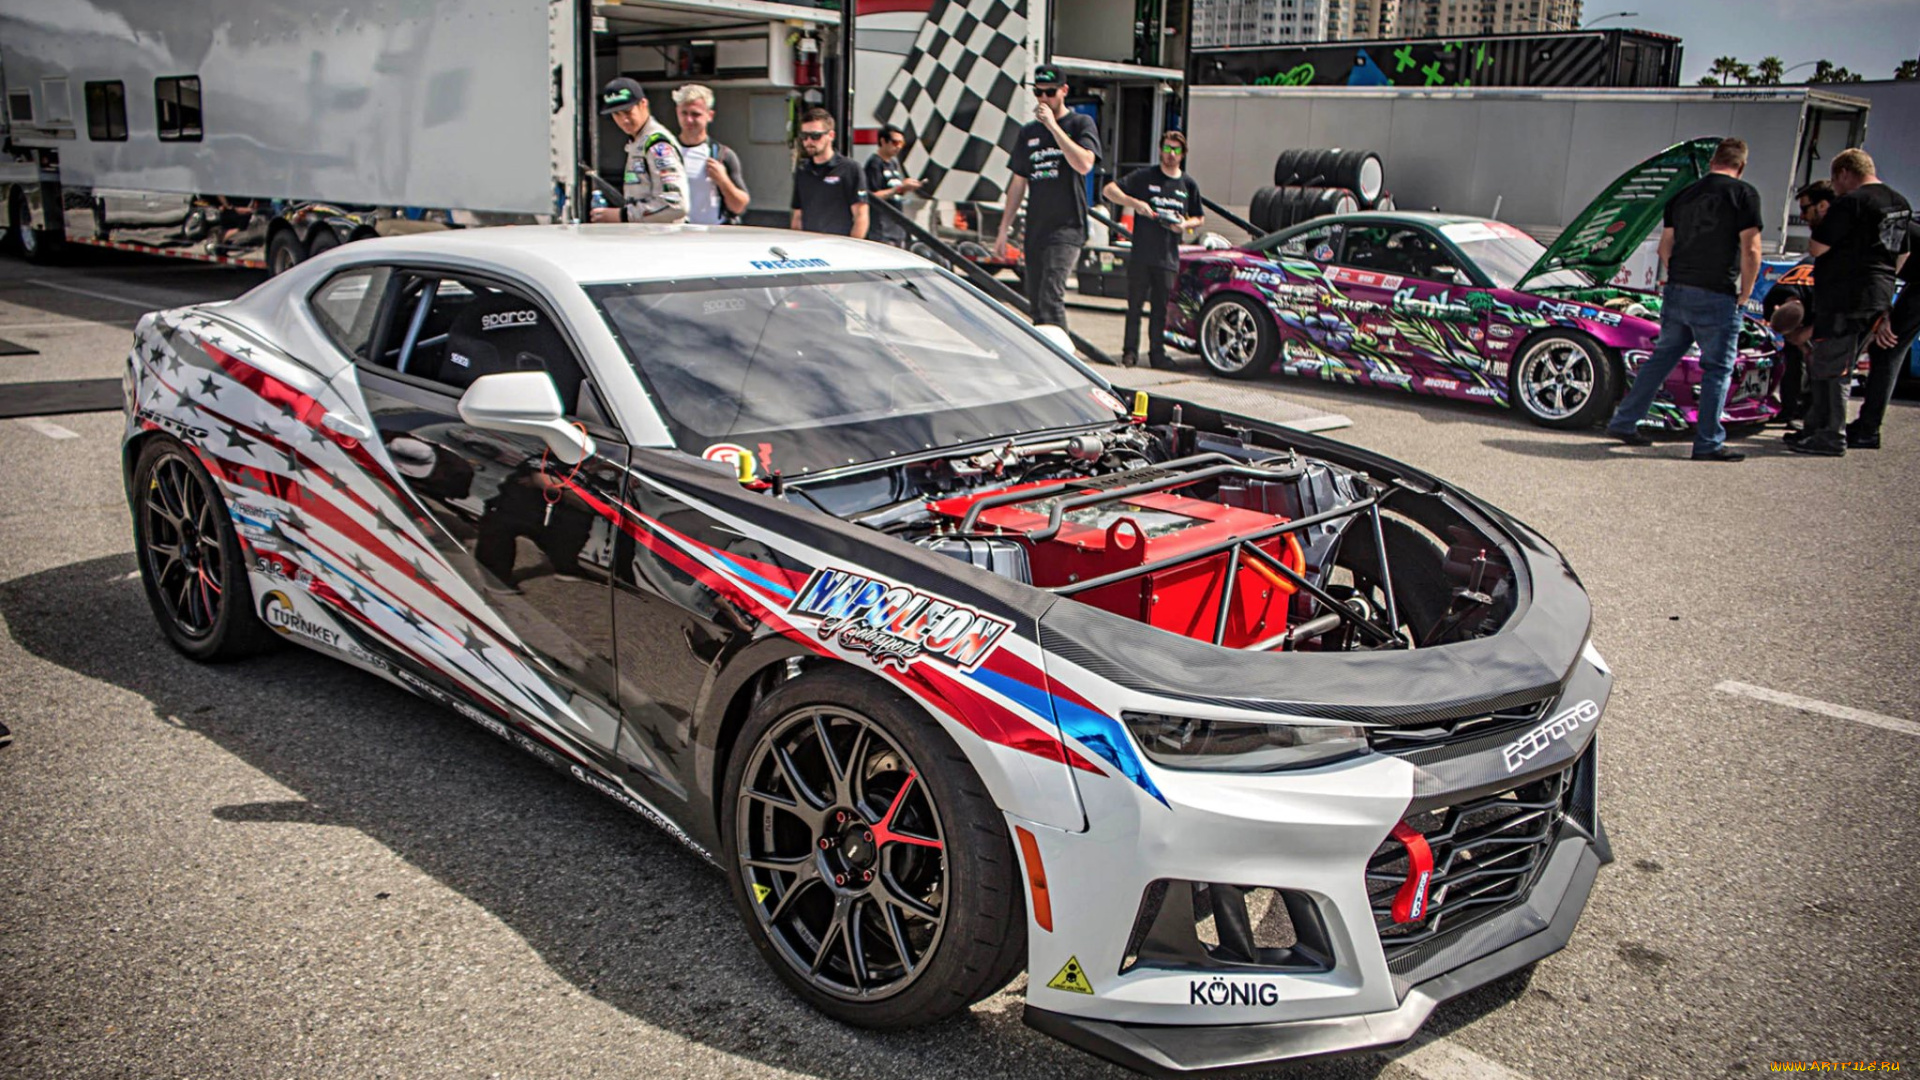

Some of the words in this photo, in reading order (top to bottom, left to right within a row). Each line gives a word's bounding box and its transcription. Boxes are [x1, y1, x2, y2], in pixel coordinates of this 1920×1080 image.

[749, 258, 831, 270] FREEDOM
[482, 310, 538, 330] sparco
[1424, 378, 1458, 391] MOTUL
[272, 607, 340, 645] TURNKEY
[797, 568, 1007, 665] NAPOLEON
[818, 616, 922, 668] Motorsports
[1503, 699, 1600, 773] NITTO
[1190, 976, 1279, 1007] KÖNIG
